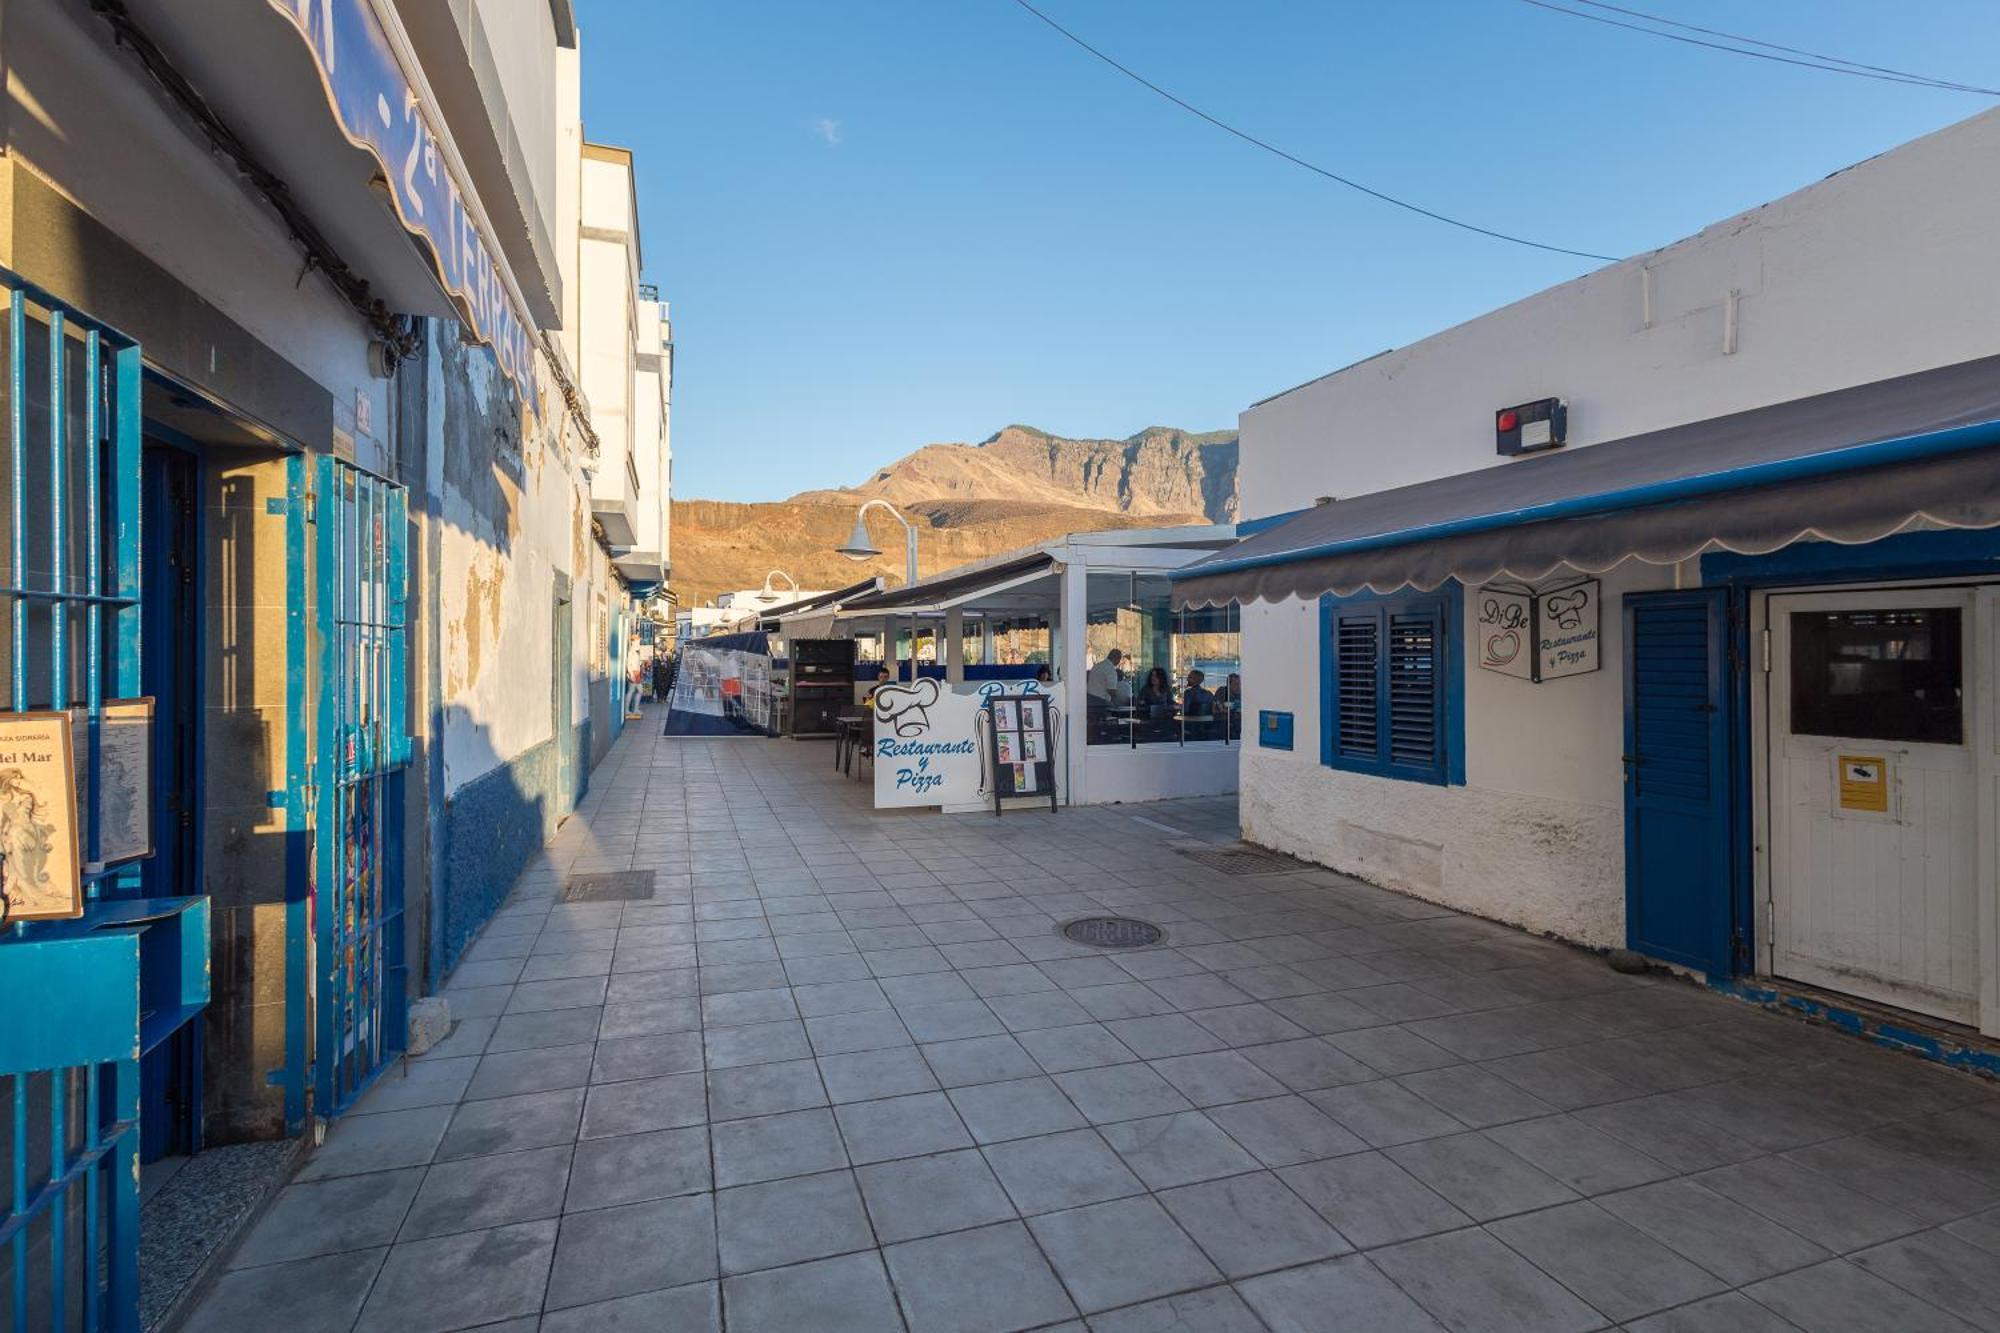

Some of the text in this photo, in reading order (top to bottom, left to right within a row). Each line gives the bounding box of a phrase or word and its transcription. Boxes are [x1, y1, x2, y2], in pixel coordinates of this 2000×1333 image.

[1540, 630, 1597, 652] Restaurante
[1549, 650, 1588, 669] y Pizza
[22, 752, 53, 763] Mar
[876, 738, 976, 758] Restaurante
[918, 756, 930, 773] y
[896, 768, 945, 794] Pizza
